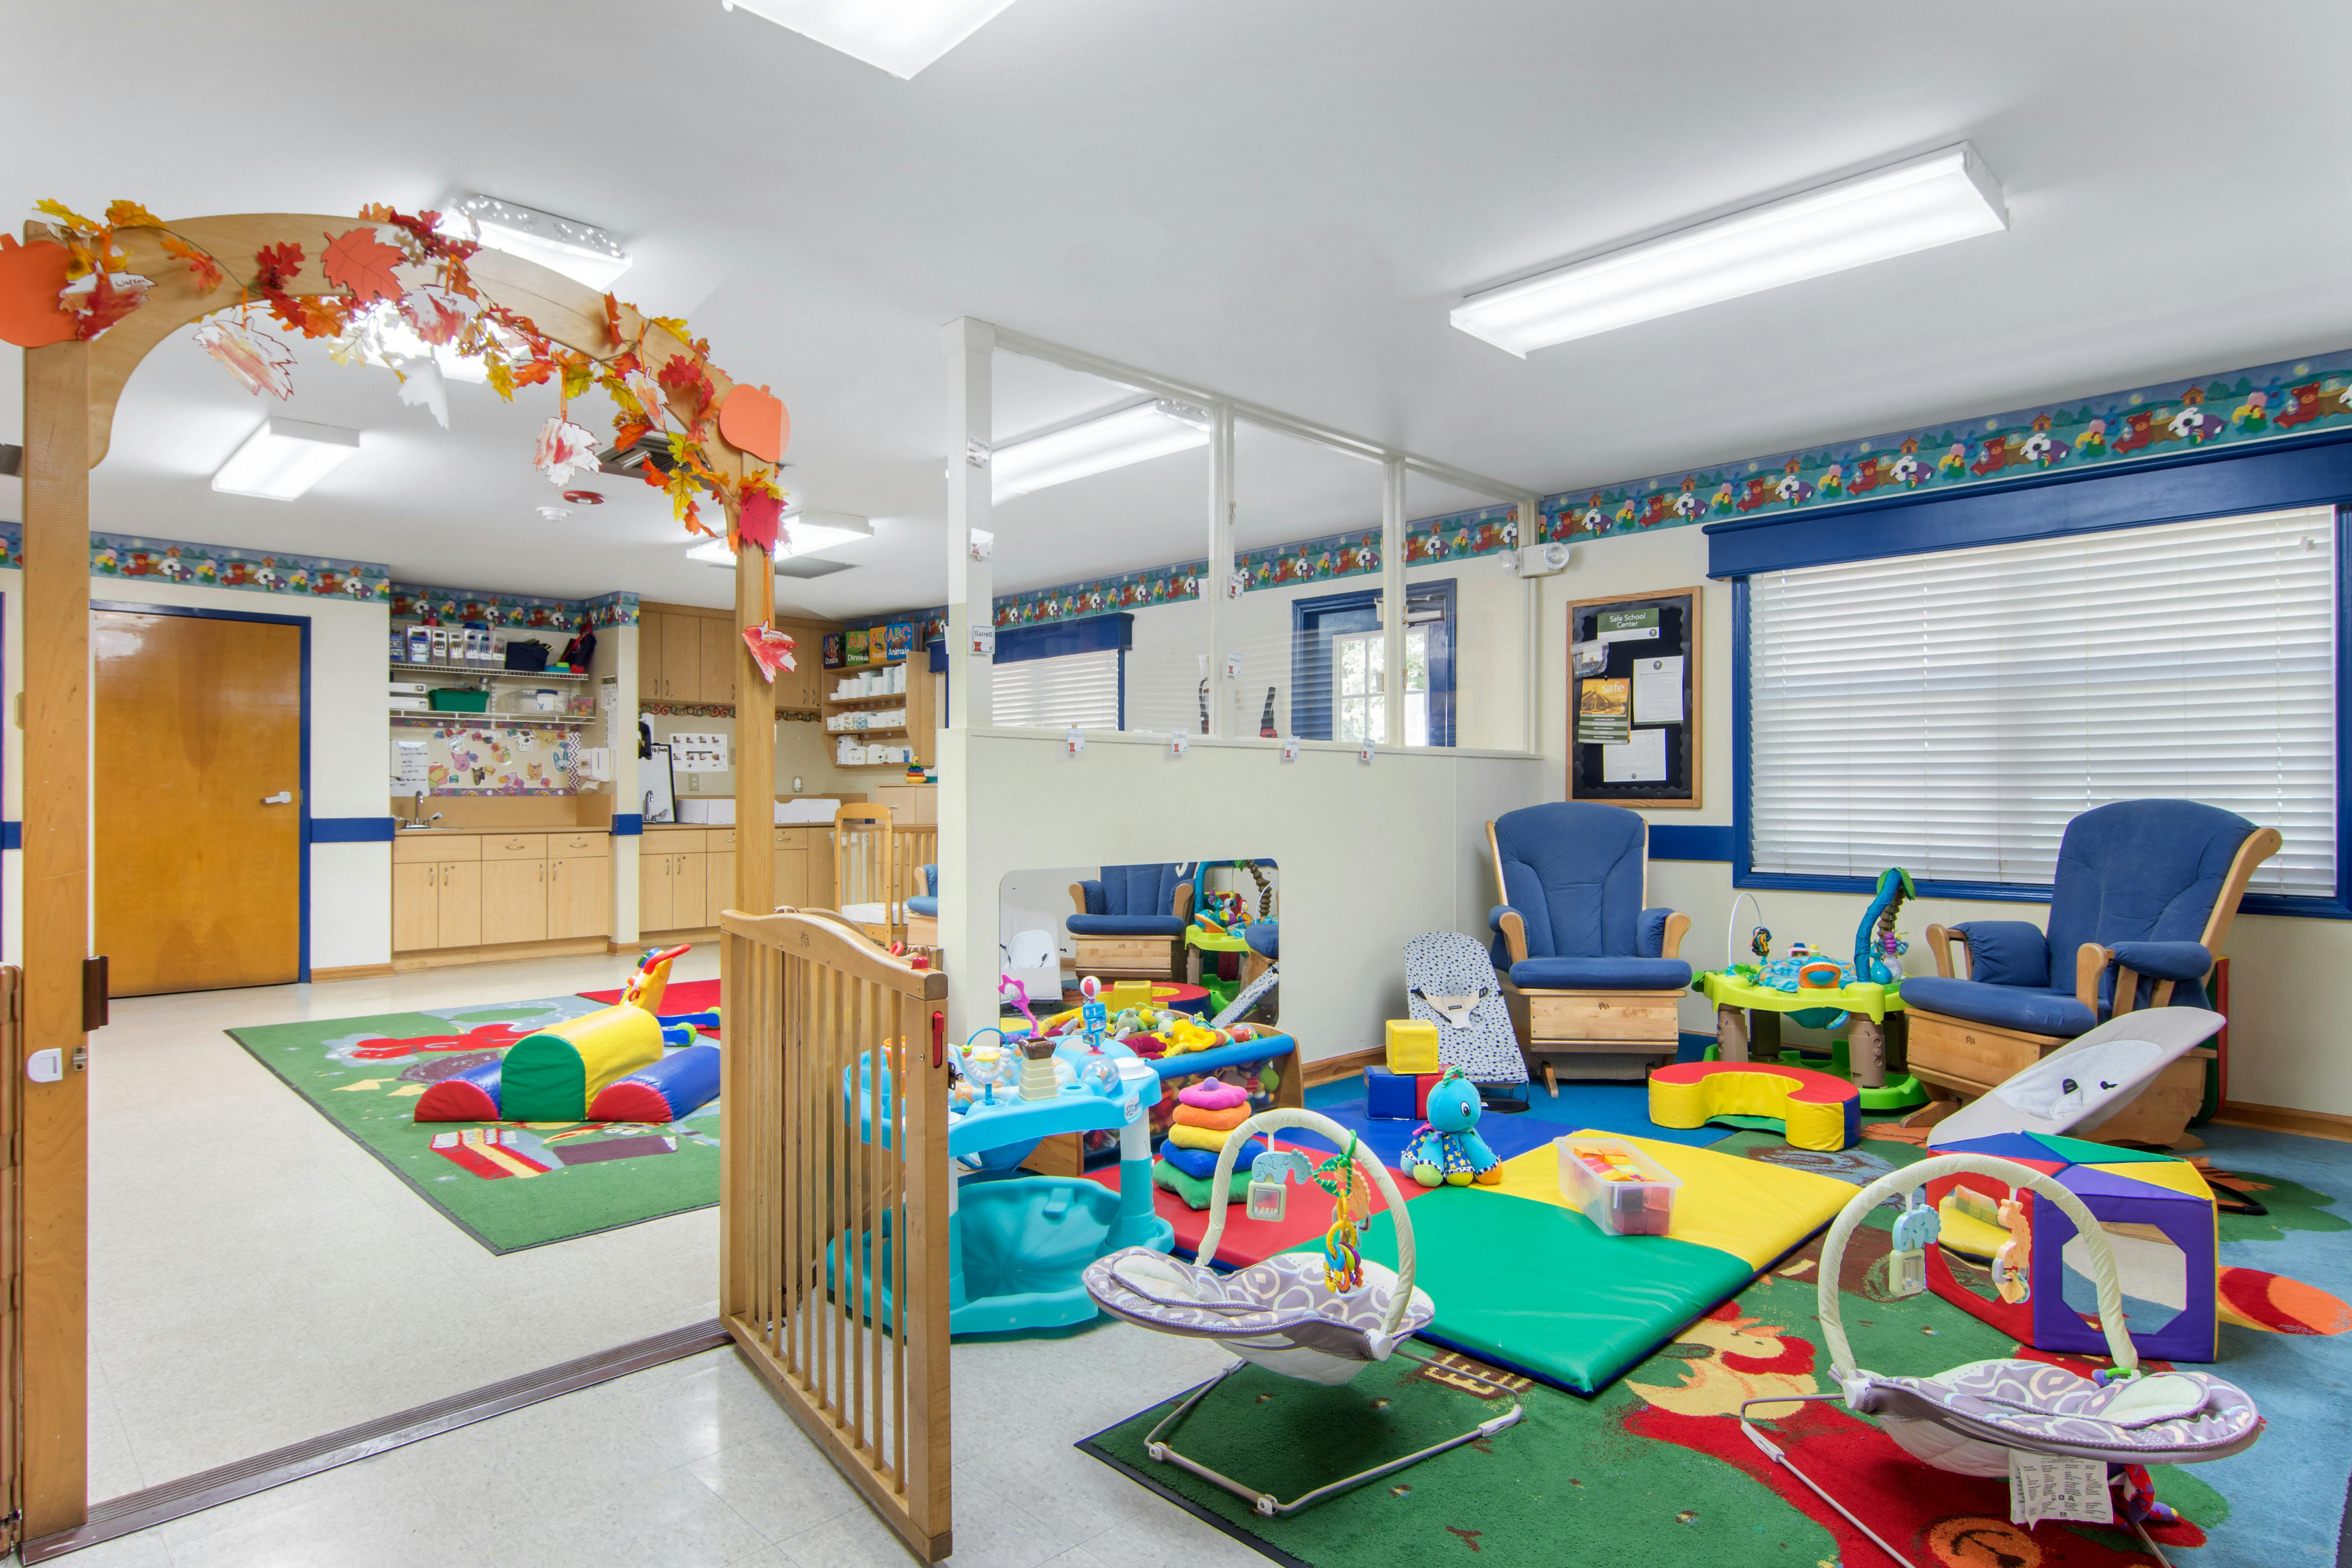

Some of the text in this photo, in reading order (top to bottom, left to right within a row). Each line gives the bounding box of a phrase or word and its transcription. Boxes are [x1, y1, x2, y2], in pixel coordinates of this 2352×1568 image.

[971, 438, 989, 450] Emerie
[887, 626, 911, 642] ABC
[824, 636, 839, 651] ABC
[1602, 682, 1625, 693] safe
